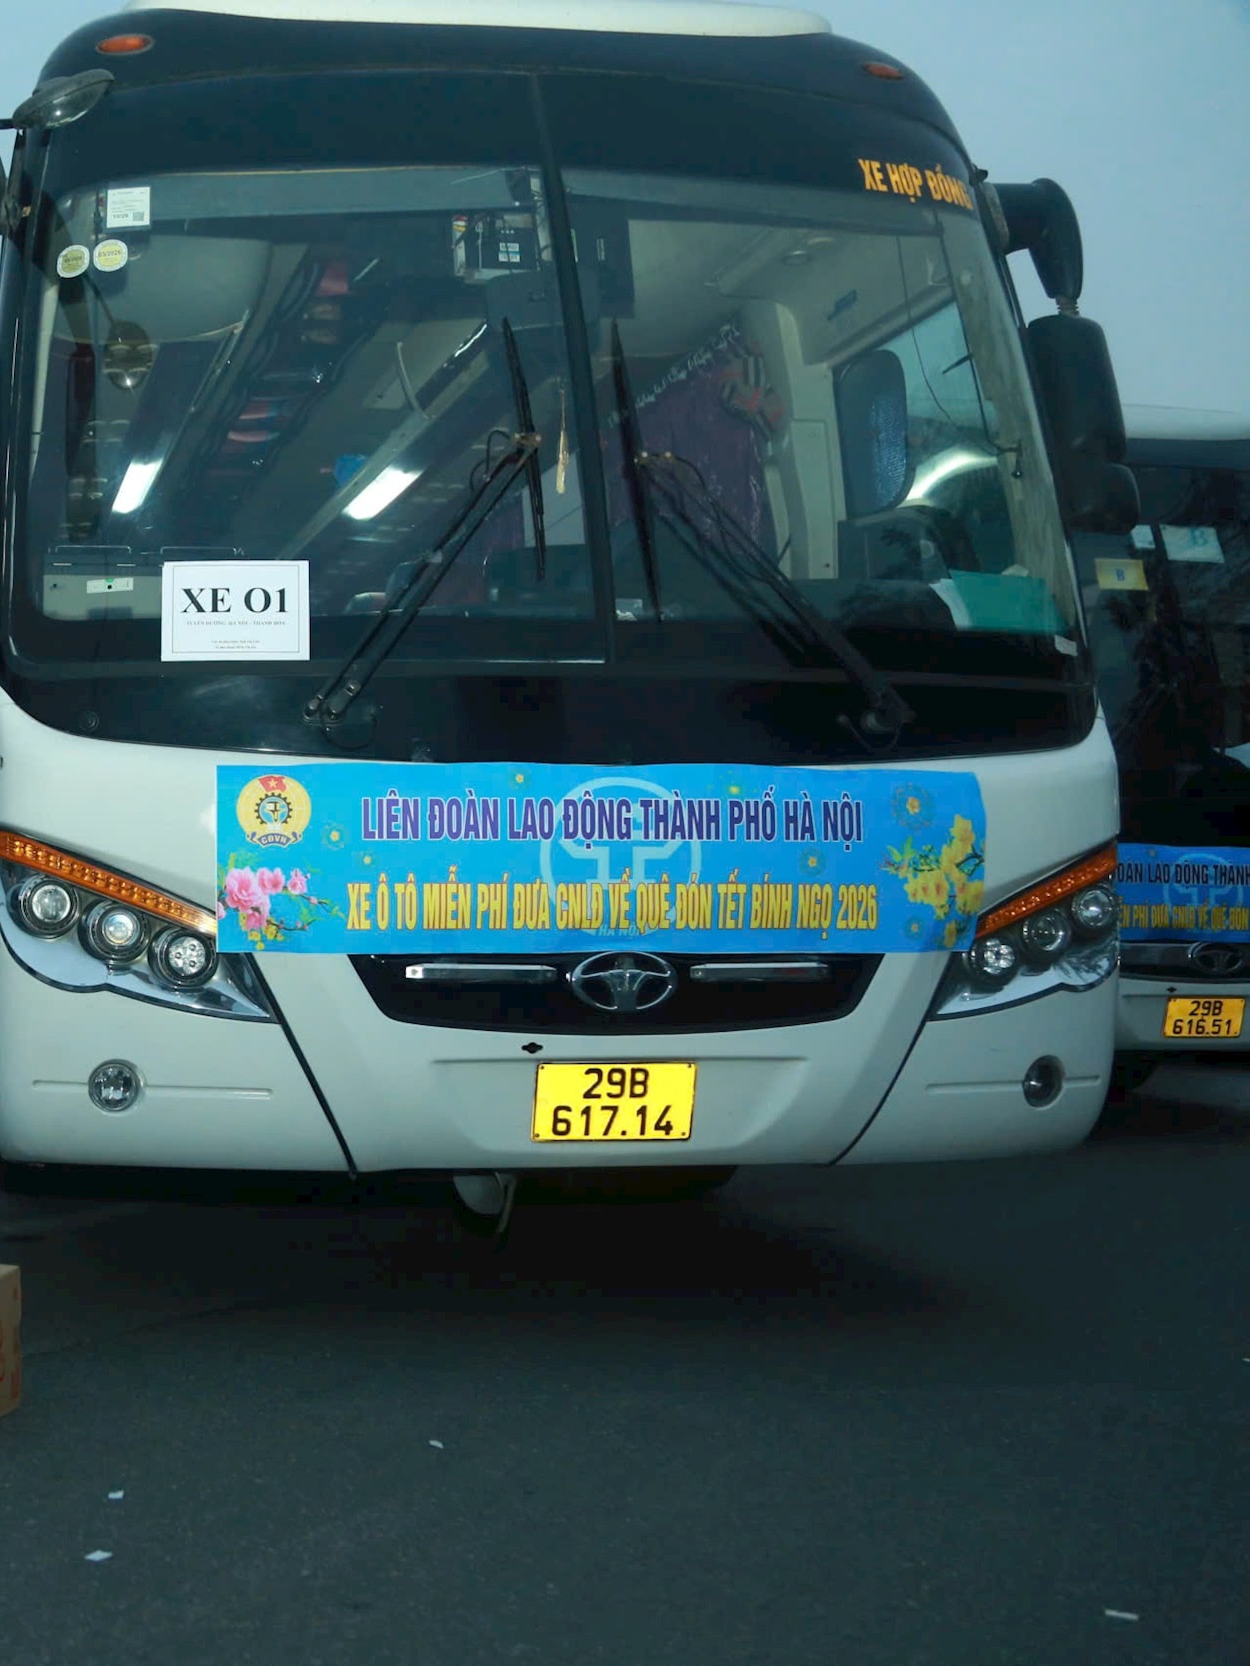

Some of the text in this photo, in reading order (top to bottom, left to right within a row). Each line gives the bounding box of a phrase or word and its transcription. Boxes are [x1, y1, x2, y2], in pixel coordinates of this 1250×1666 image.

[858, 158, 974, 211] XE HỢP ĐỒNG
[180, 587, 232, 614] XE
[362, 785, 863, 852] LIÊN ĐOÀN LAO ĐỘNG THÀNH PHỐ HÀ NỘI
[1116, 860, 1143, 883] OÀN
[1147, 862, 1170, 884] LAO
[1174, 859, 1209, 890] ĐỘNG
[346, 865, 879, 940] XE Ô TÔ MIỄN PHÍ ĐƯA CNLĐ VỀ QUÊ ĐÓN TẾT BÍNH NGỌ 2026
[1189, 1000, 1223, 1016] 29B
[1172, 1018, 1232, 1035] 616.51
[583, 1067, 650, 1099] 29B
[551, 1105, 674, 1136] 617.14
